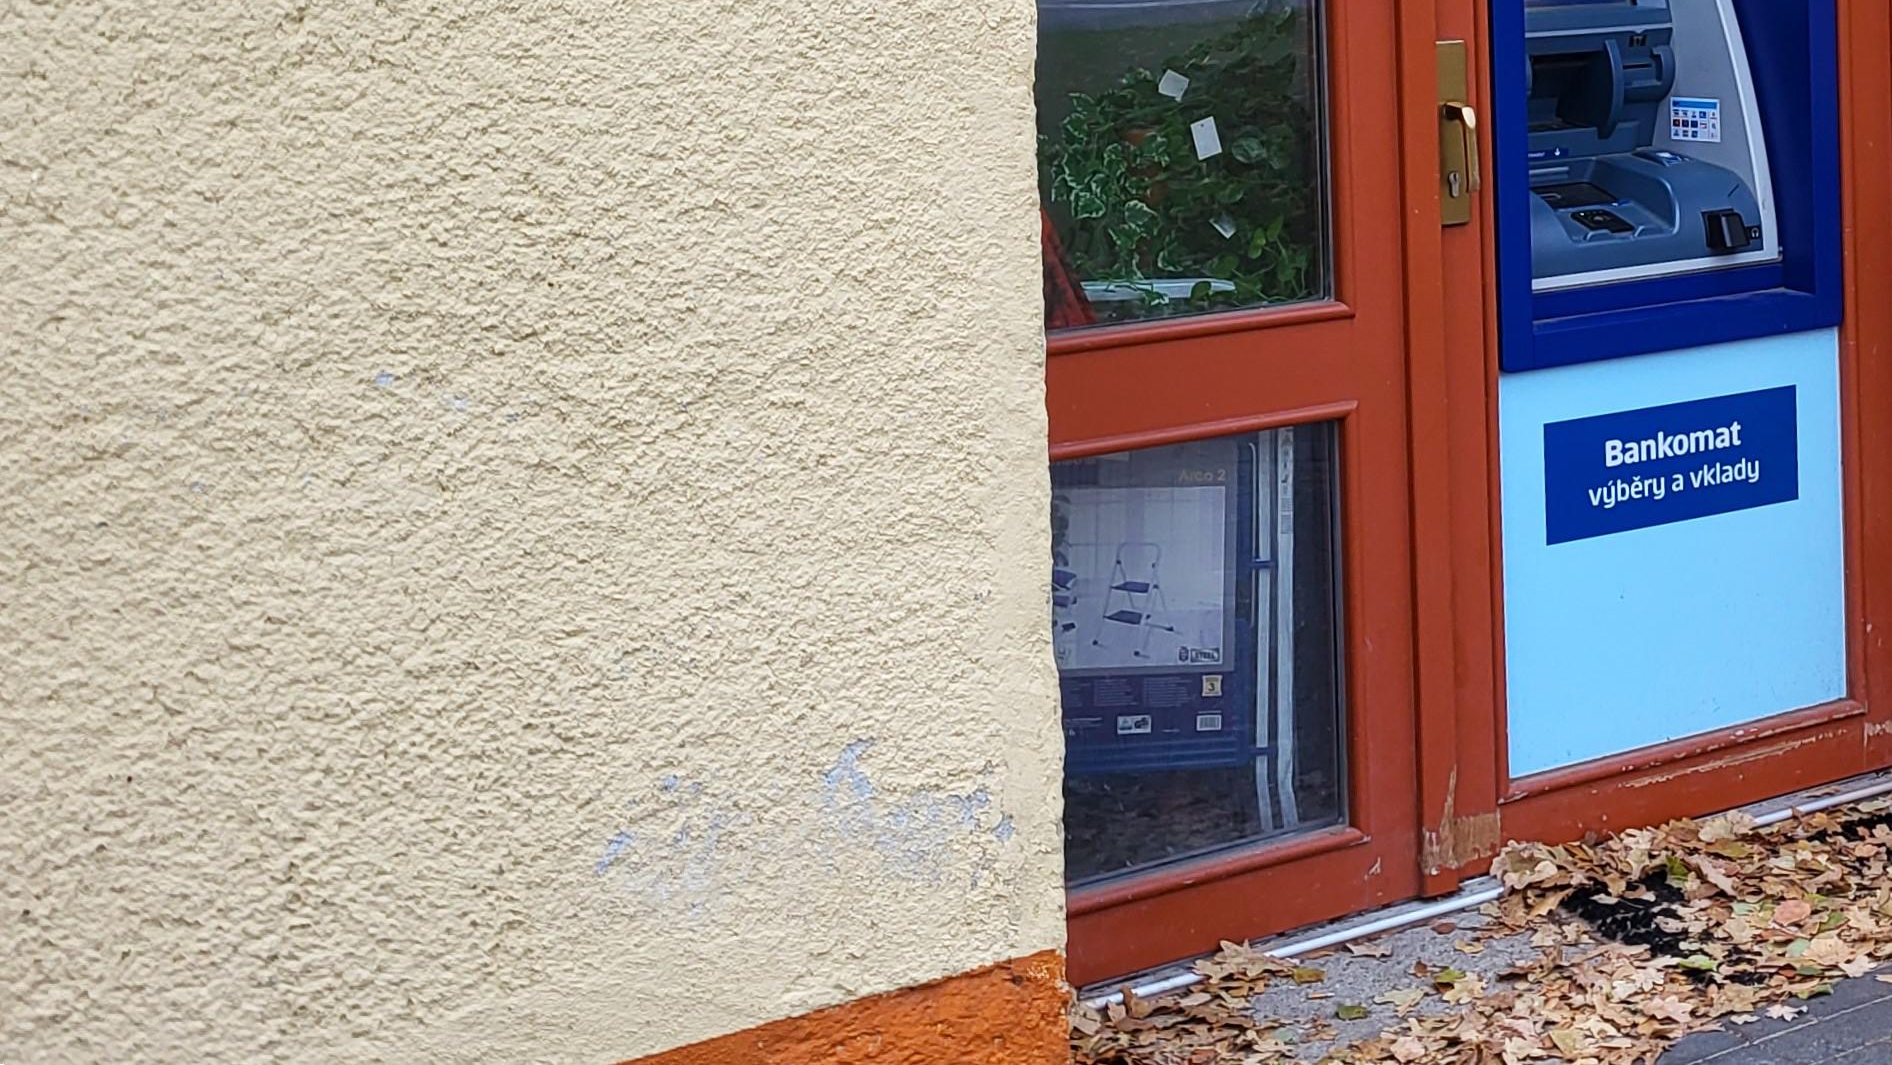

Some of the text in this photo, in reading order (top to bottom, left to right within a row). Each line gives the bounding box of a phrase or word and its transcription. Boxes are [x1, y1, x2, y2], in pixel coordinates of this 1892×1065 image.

[1605, 421, 1741, 467] Bankomat
[1588, 458, 1760, 509] výběry a vklady
